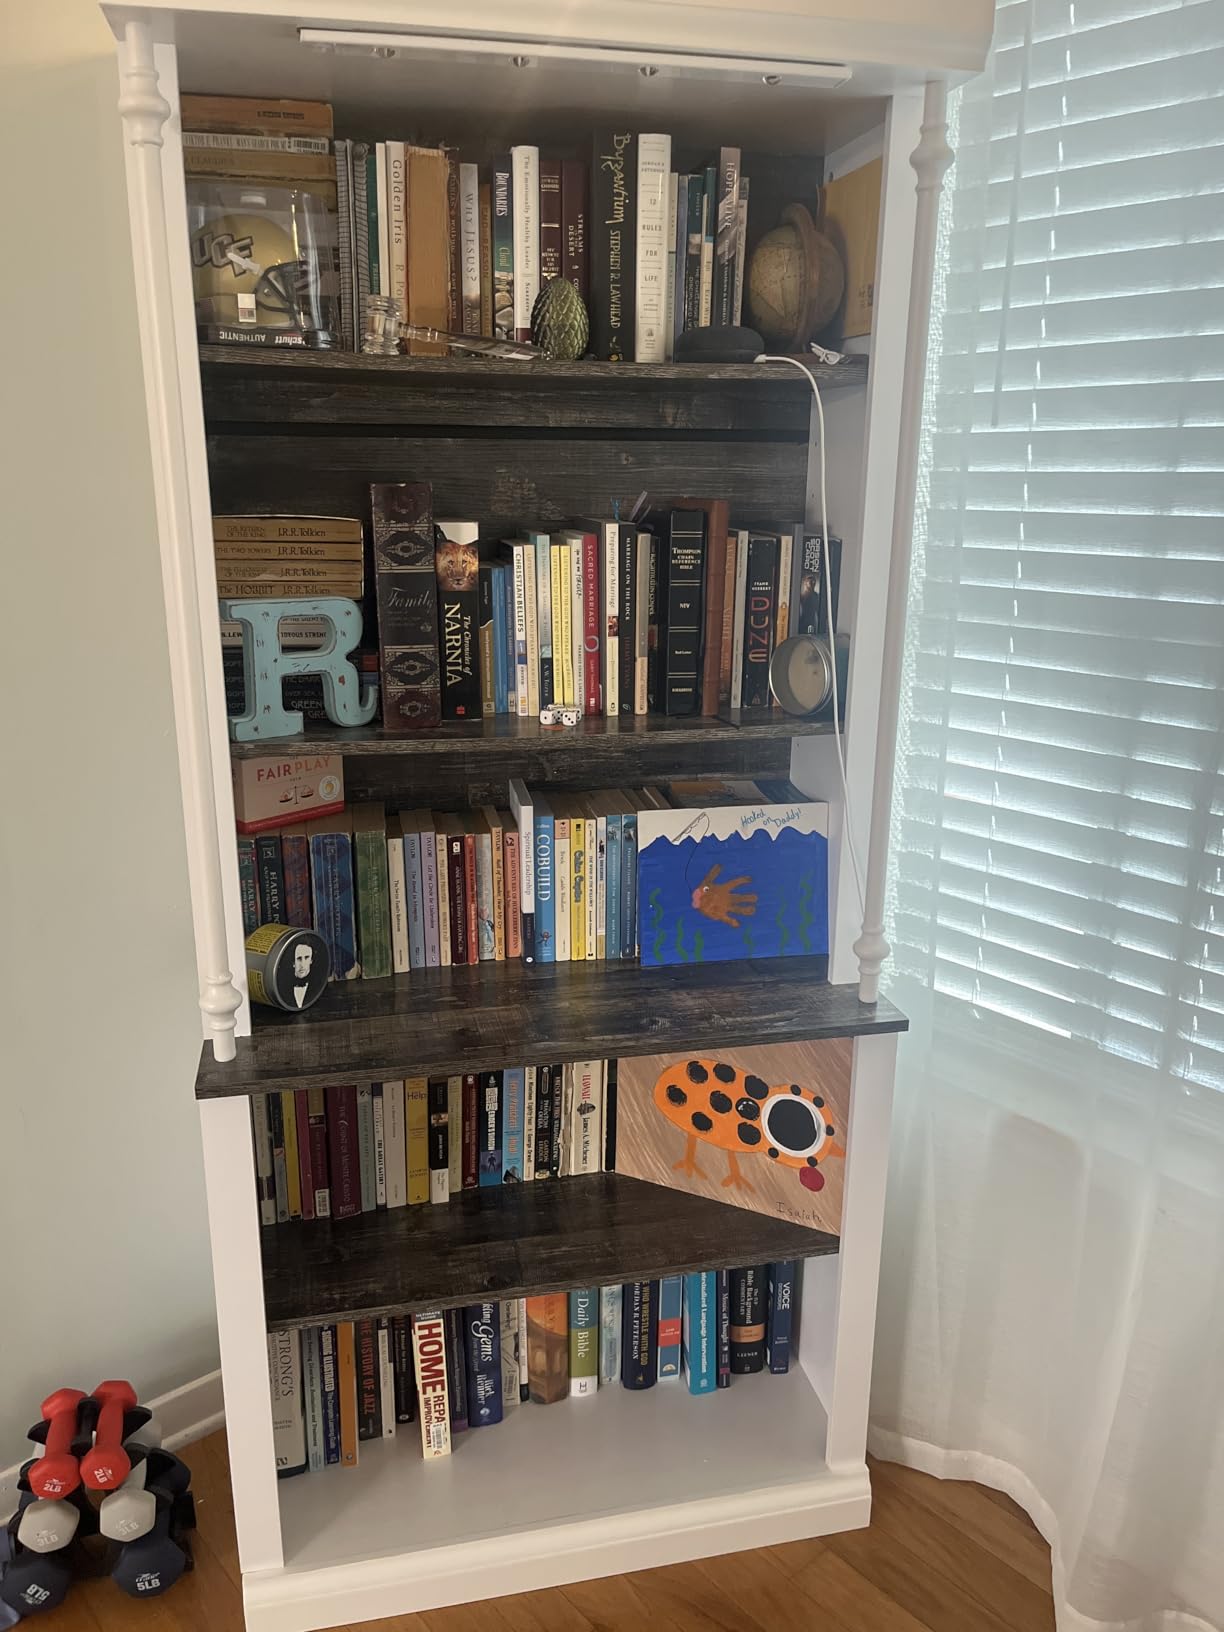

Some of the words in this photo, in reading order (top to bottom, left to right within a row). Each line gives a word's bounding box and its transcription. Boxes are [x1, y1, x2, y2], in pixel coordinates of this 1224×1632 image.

[392, 160, 403, 212] Golden
[600, 133, 632, 224] Byzantium
[725, 162, 735, 193] HOPE
[495, 172, 509, 216] BOUNDARIES
[465, 193, 473, 224] WHY
[724, 198, 734, 228] ALIVE
[394, 219, 404, 244] Iris
[642, 224, 662, 232] RULES
[191, 232, 253, 277] UCF
[465, 231, 477, 282] JESUS?
[499, 247, 510, 266] Cloud
[610, 230, 621, 270] STEPHEN
[645, 249, 658, 257] FOR
[610, 273, 621, 281] R.
[610, 284, 621, 329] LAWHEAD
[219, 331, 266, 342] AUTHENTIC
[278, 527, 298, 537] J.R.R.
[298, 527, 326, 537] Tolkien
[277, 547, 298, 556] J.R.R.
[298, 547, 325, 556] Tolkien
[609, 531, 617, 564] Preparing
[280, 568, 300, 578] J.R.R.
[300, 568, 327, 577] Tolkien
[625, 574, 630, 585] ON
[219, 585, 233, 594] The
[235, 585, 274, 595] HOBBIT
[282, 586, 304, 595] J.R.R.
[304, 586, 330, 594] Tolkien
[388, 587, 433, 614] Family
[609, 578, 617, 608] Marriage
[463, 616, 471, 629] The
[748, 597, 770, 663] DUNE
[444, 602, 463, 687] NARNIA
[463, 631, 471, 663] Chronicles
[222, 597, 377, 741] R
[463, 666, 472, 676] of
[740, 808, 767, 828] Hooked
[762, 817, 773, 826] on
[774, 807, 802, 827] Daddy!
[524, 860, 532, 895] Leadership
[537, 834, 551, 901] COBUILD
[270, 872, 279, 909] HARRY
[497, 911, 503, 920] My
[407, 1092, 427, 1101] Help
[582, 1074, 591, 1100] HAWAII
[582, 1117, 590, 1133] James
[582, 1140, 590, 1165] Michener
[776, 1201, 823, 1223] Isaiah
[745, 1287, 753, 1324] Background
[781, 1282, 791, 1309] VOICE
[481, 1303, 493, 1323] kling
[574, 1298, 588, 1327] Daily
[641, 1304, 649, 1333] WRESTLE
[322, 1330, 333, 1355] SIGNING
[471, 1320, 494, 1362] Gems
[577, 1331, 588, 1358] Bible
[720, 1321, 728, 1343] Thought
[279, 1330, 294, 1397] STRONG'S
[361, 1338, 374, 1376] HISTORY
[418, 1322, 446, 1395] HOME
[640, 1353, 648, 1365] GOD
[323, 1356, 334, 1392] ILLUSTRATED
[363, 1379, 374, 1390] OF
[476, 1374, 487, 1405] Renner
[484, 1379, 495, 1397] Rick
[364, 1393, 375, 1415] JAZZ
[43, 1483, 62, 1493] 2LB
[94, 1468, 108, 1483] 2LB
[36, 1534, 58, 1547] 3LB
[118, 1522, 140, 1536] 3LB
[26, 1583, 50, 1601] 5LB
[136, 1578, 161, 1591] 5LB
